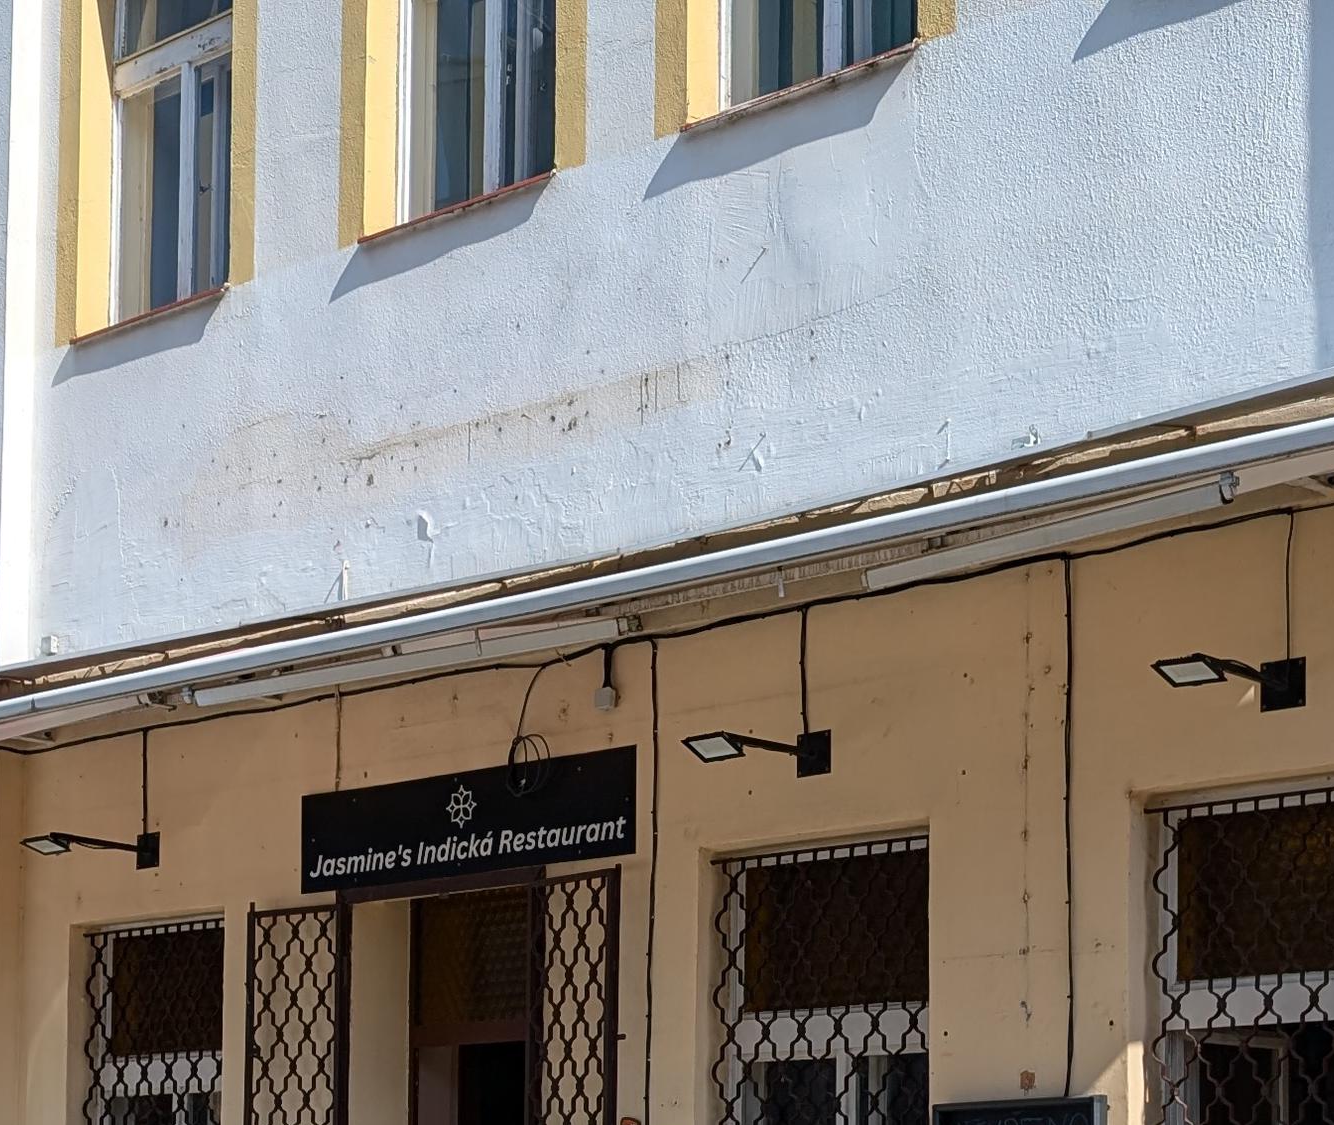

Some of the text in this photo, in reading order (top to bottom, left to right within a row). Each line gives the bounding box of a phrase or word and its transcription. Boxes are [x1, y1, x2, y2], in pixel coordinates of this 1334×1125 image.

[310, 815, 627, 878] Jasmine's Indická Restaurant
